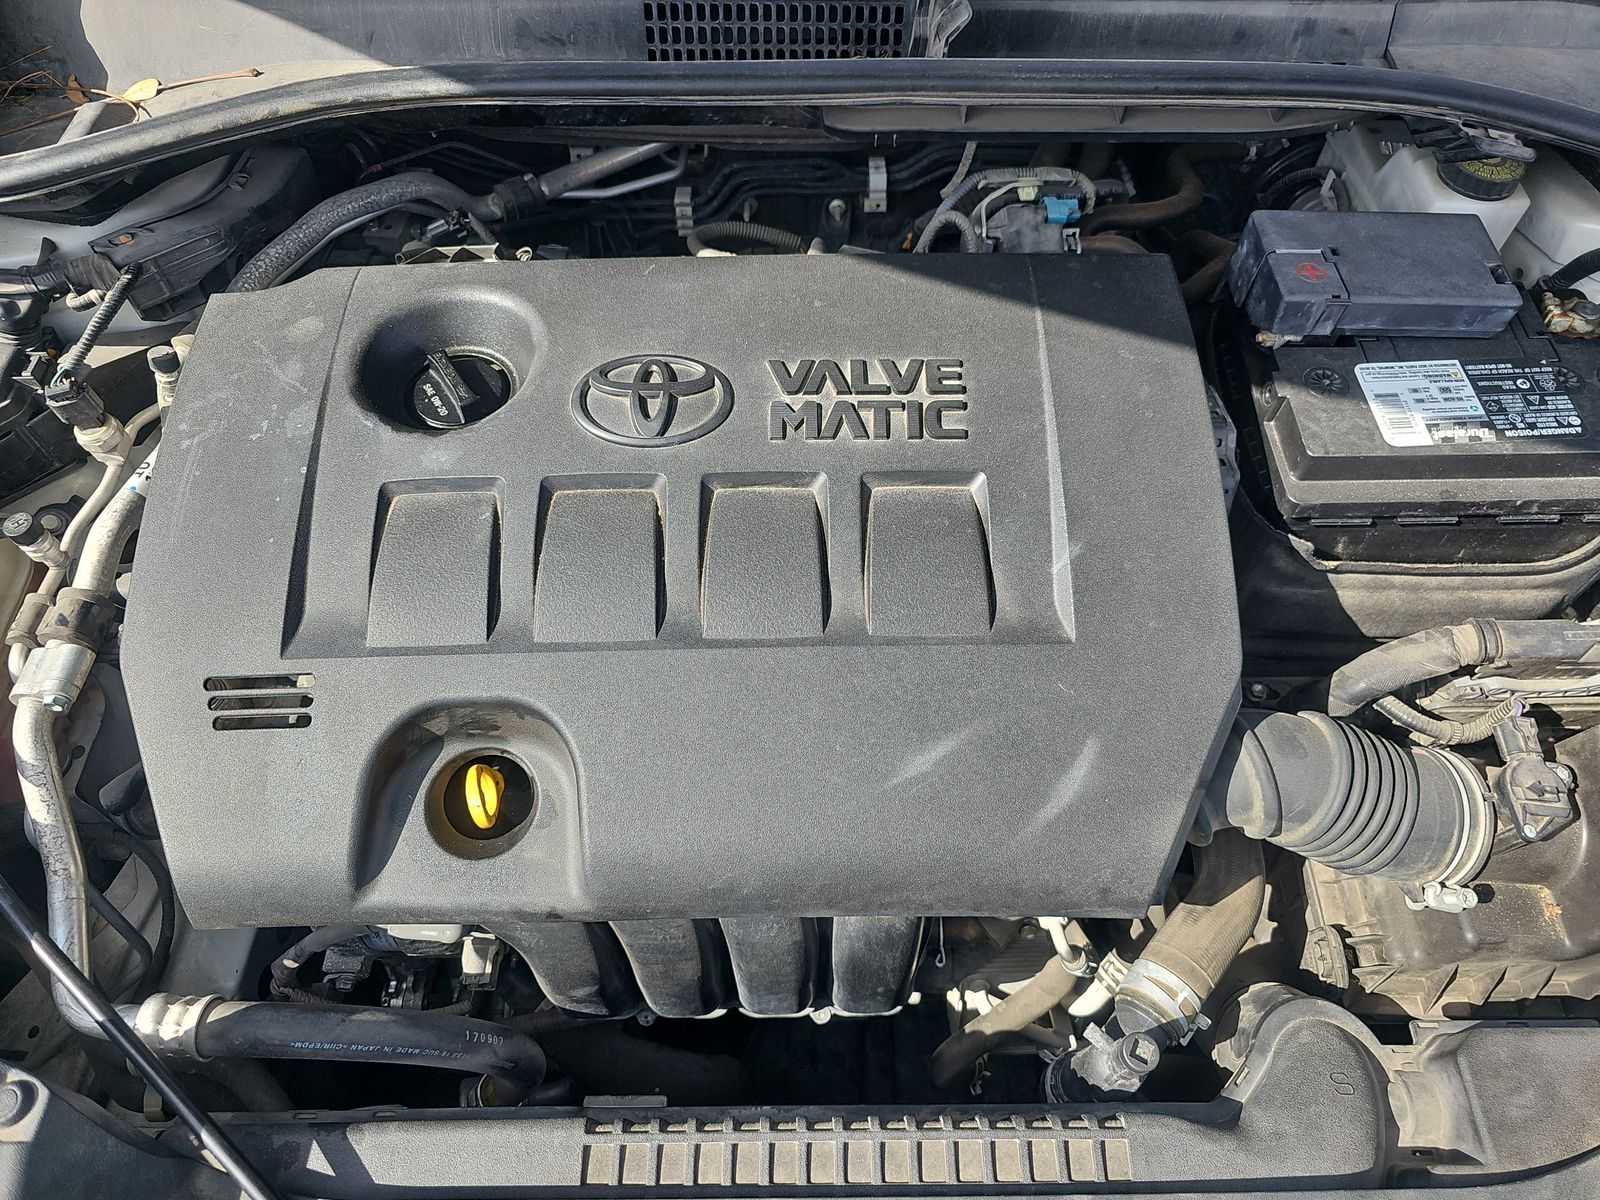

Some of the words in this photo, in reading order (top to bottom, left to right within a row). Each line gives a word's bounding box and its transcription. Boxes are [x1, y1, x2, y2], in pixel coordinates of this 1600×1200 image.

[767, 359, 967, 395] VALVE
[423, 383, 436, 396] SAE
[769, 400, 969, 440] MATIC
[1431, 428, 1494, 442] Duralast
[1504, 427, 1577, 437] DANGER/POISON
[465, 1030, 504, 1047] 170907
[350, 1044, 380, 1052] JAPAN
